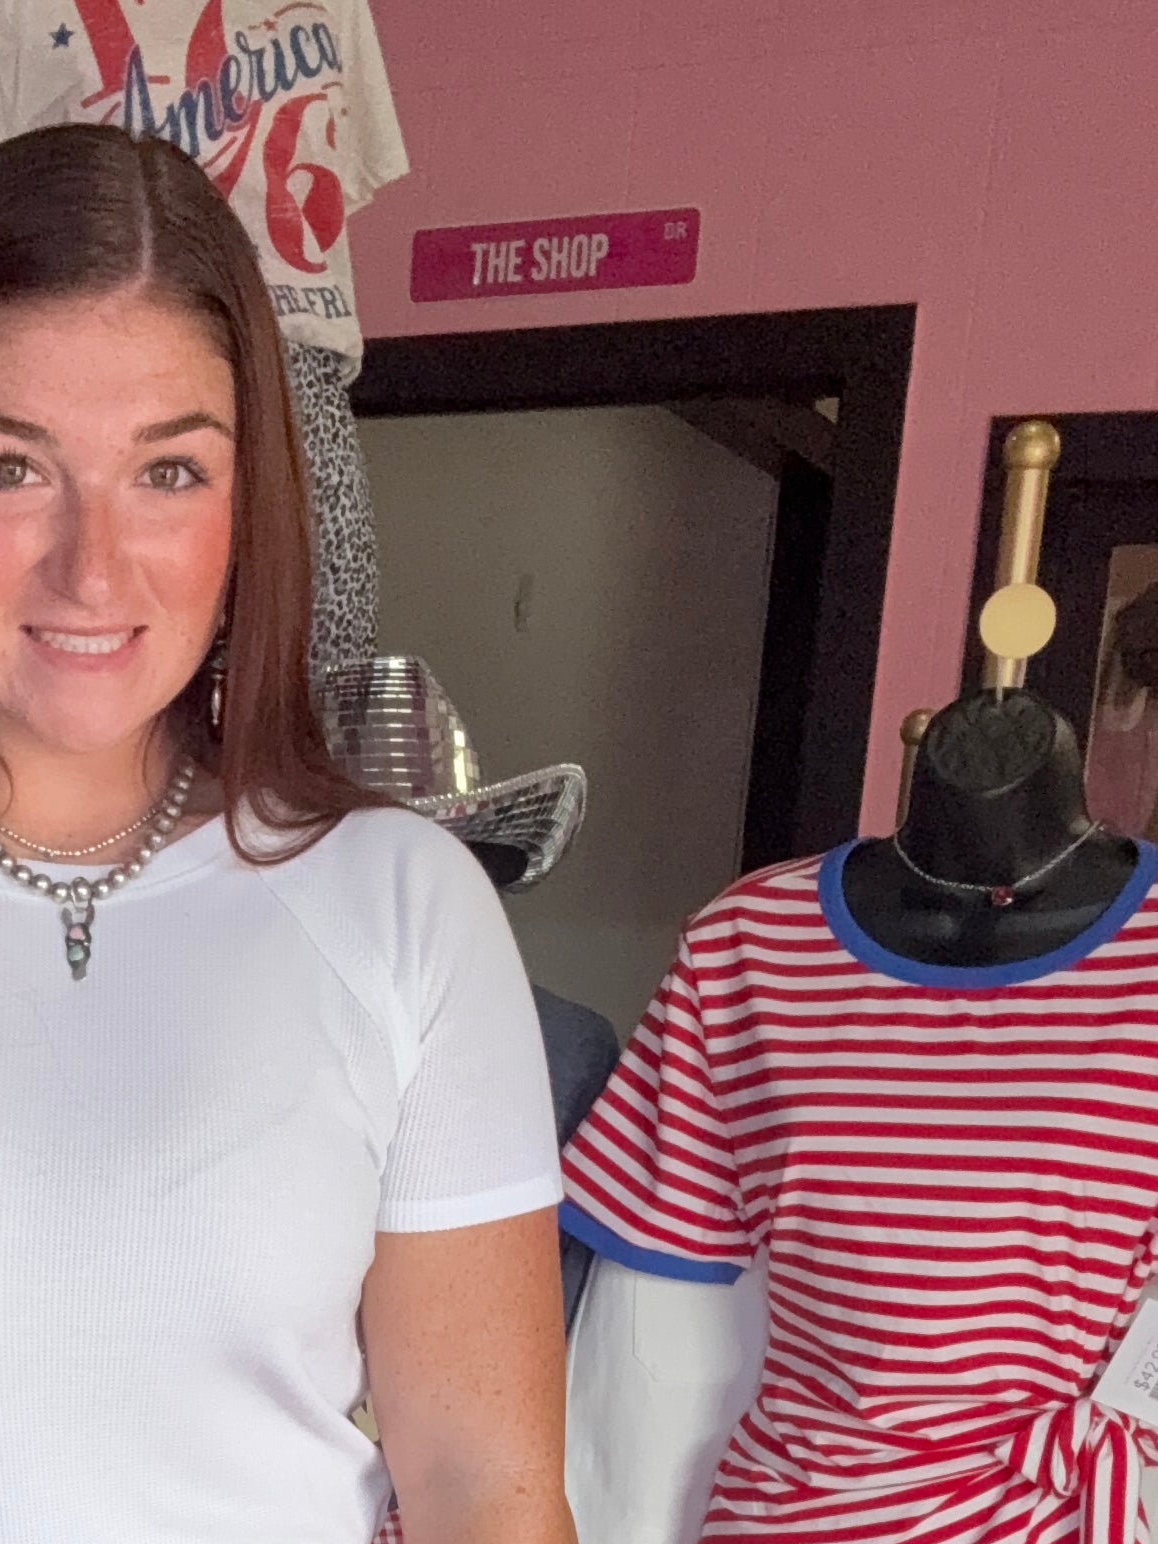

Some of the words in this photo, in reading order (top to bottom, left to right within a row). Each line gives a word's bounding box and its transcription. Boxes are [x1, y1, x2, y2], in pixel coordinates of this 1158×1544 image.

[123, 22, 342, 159] America
[470, 240, 526, 286] THE
[530, 232, 610, 281] SHOP
